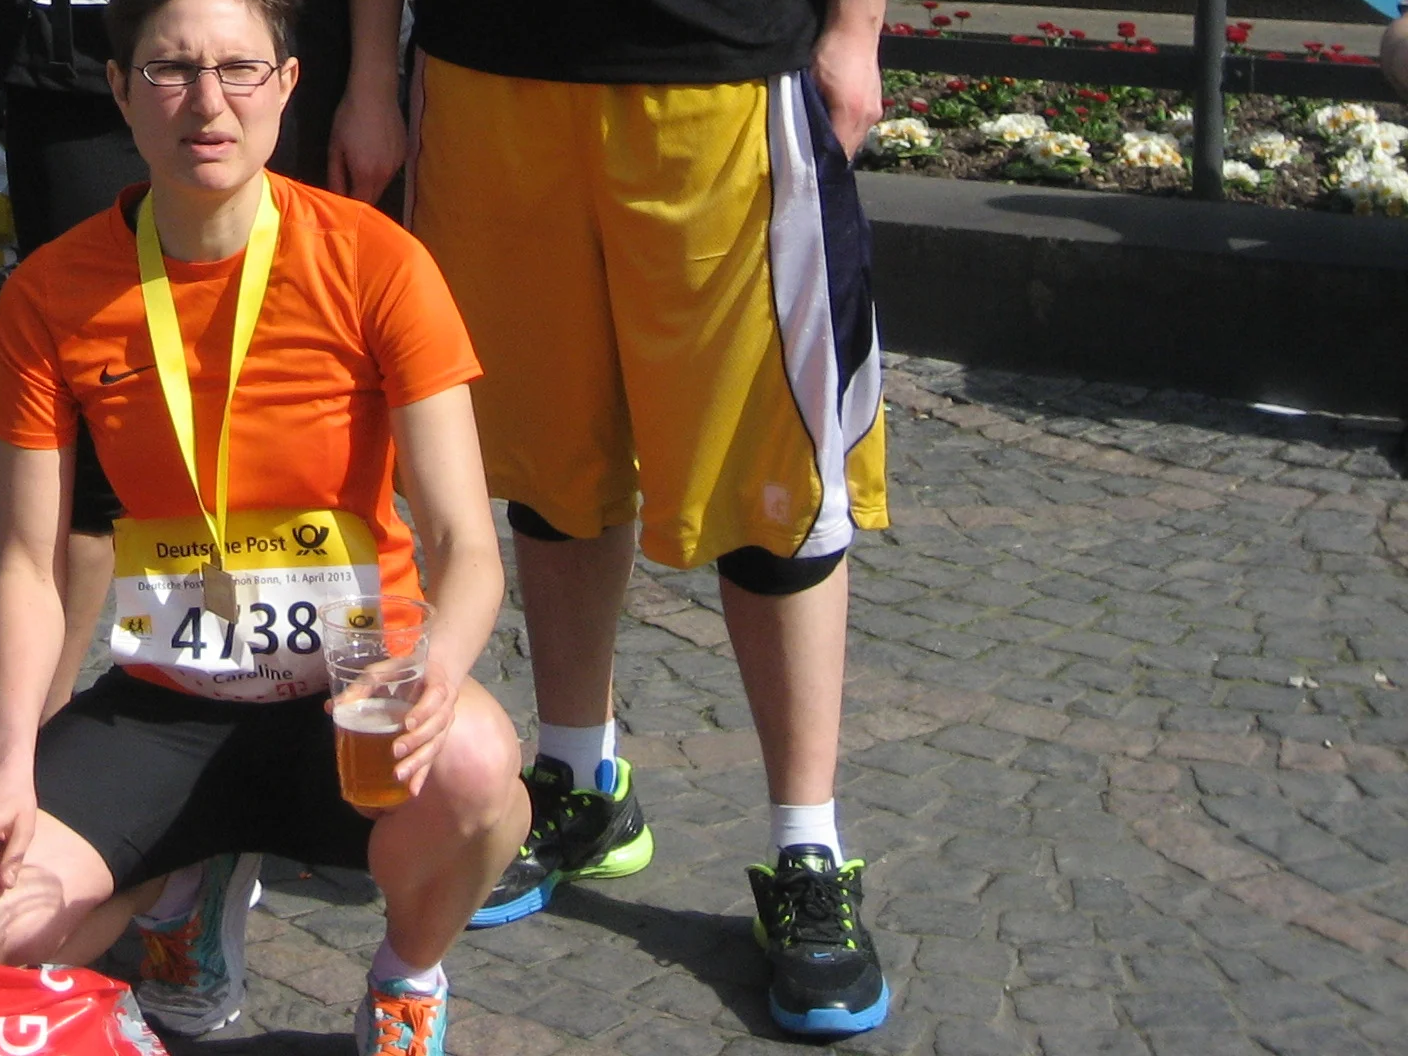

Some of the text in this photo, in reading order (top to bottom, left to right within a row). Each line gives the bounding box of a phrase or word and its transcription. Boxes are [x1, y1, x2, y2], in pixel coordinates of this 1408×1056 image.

[246, 536, 288, 553] Post
[138, 580, 204, 591] Deutsche Post
[254, 575, 282, 586] Bonn,
[286, 574, 300, 583] 14.
[302, 572, 325, 584] April
[327, 572, 352, 582] 2013
[213, 664, 293, 684] Caroline
